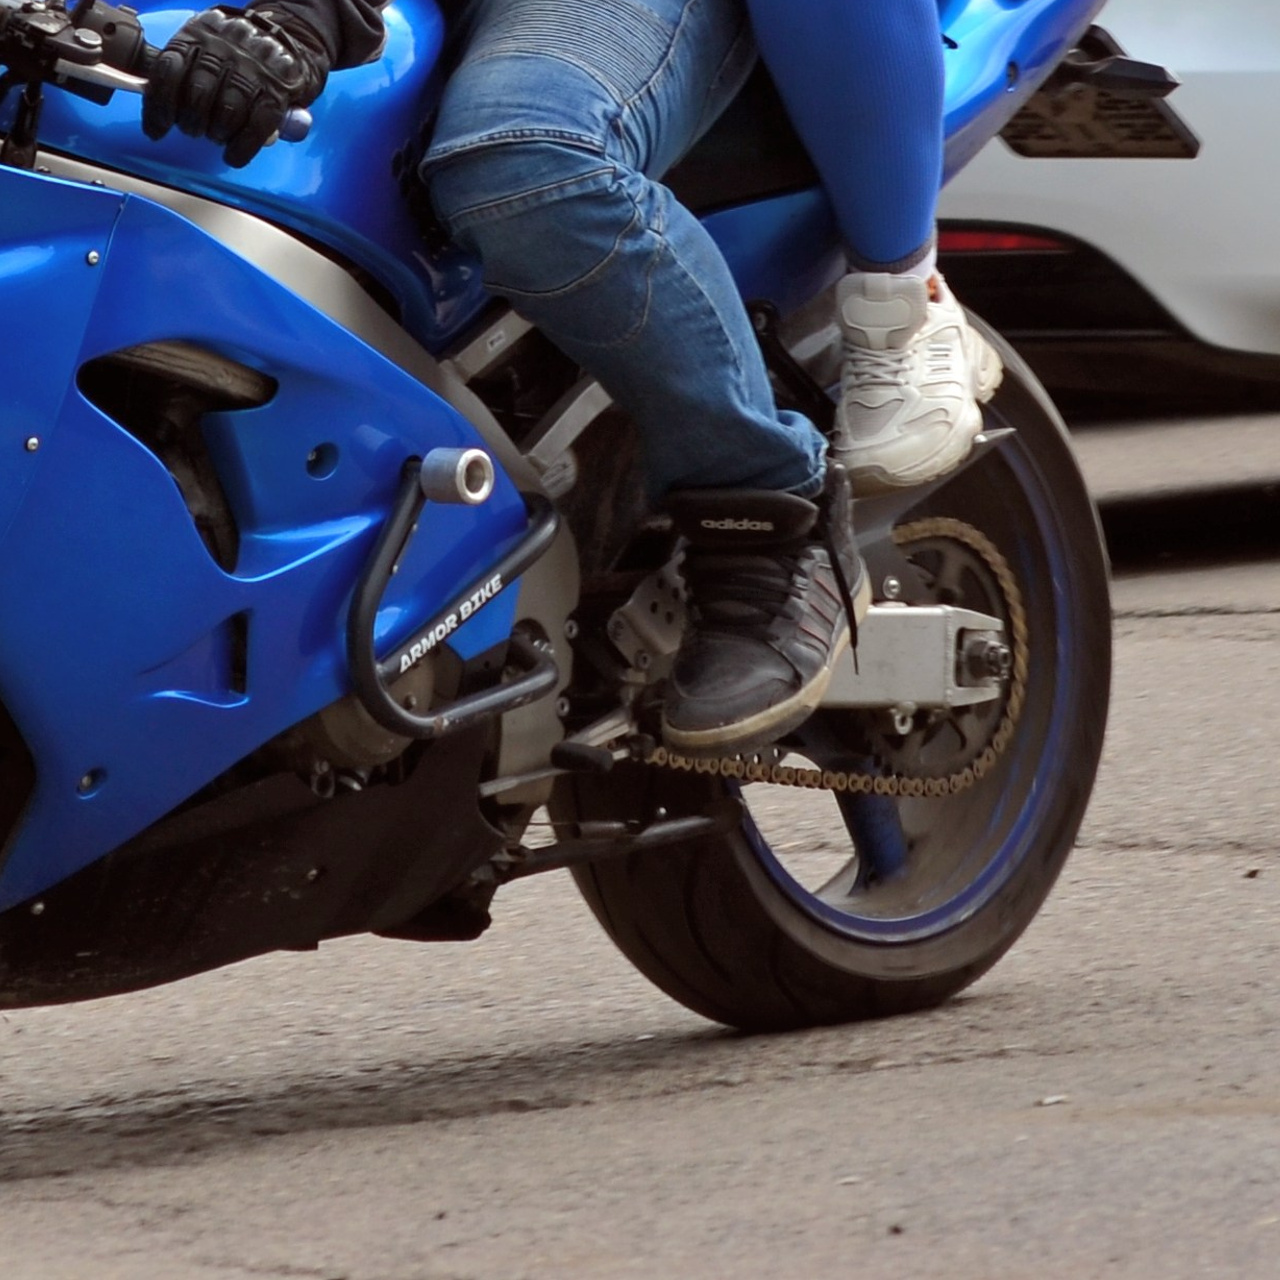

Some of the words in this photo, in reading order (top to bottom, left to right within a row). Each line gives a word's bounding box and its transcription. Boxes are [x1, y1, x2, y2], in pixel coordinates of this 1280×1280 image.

[700, 518, 774, 531] adidas
[400, 613, 458, 673] ARMOR
[459, 573, 502, 621] BIKE
